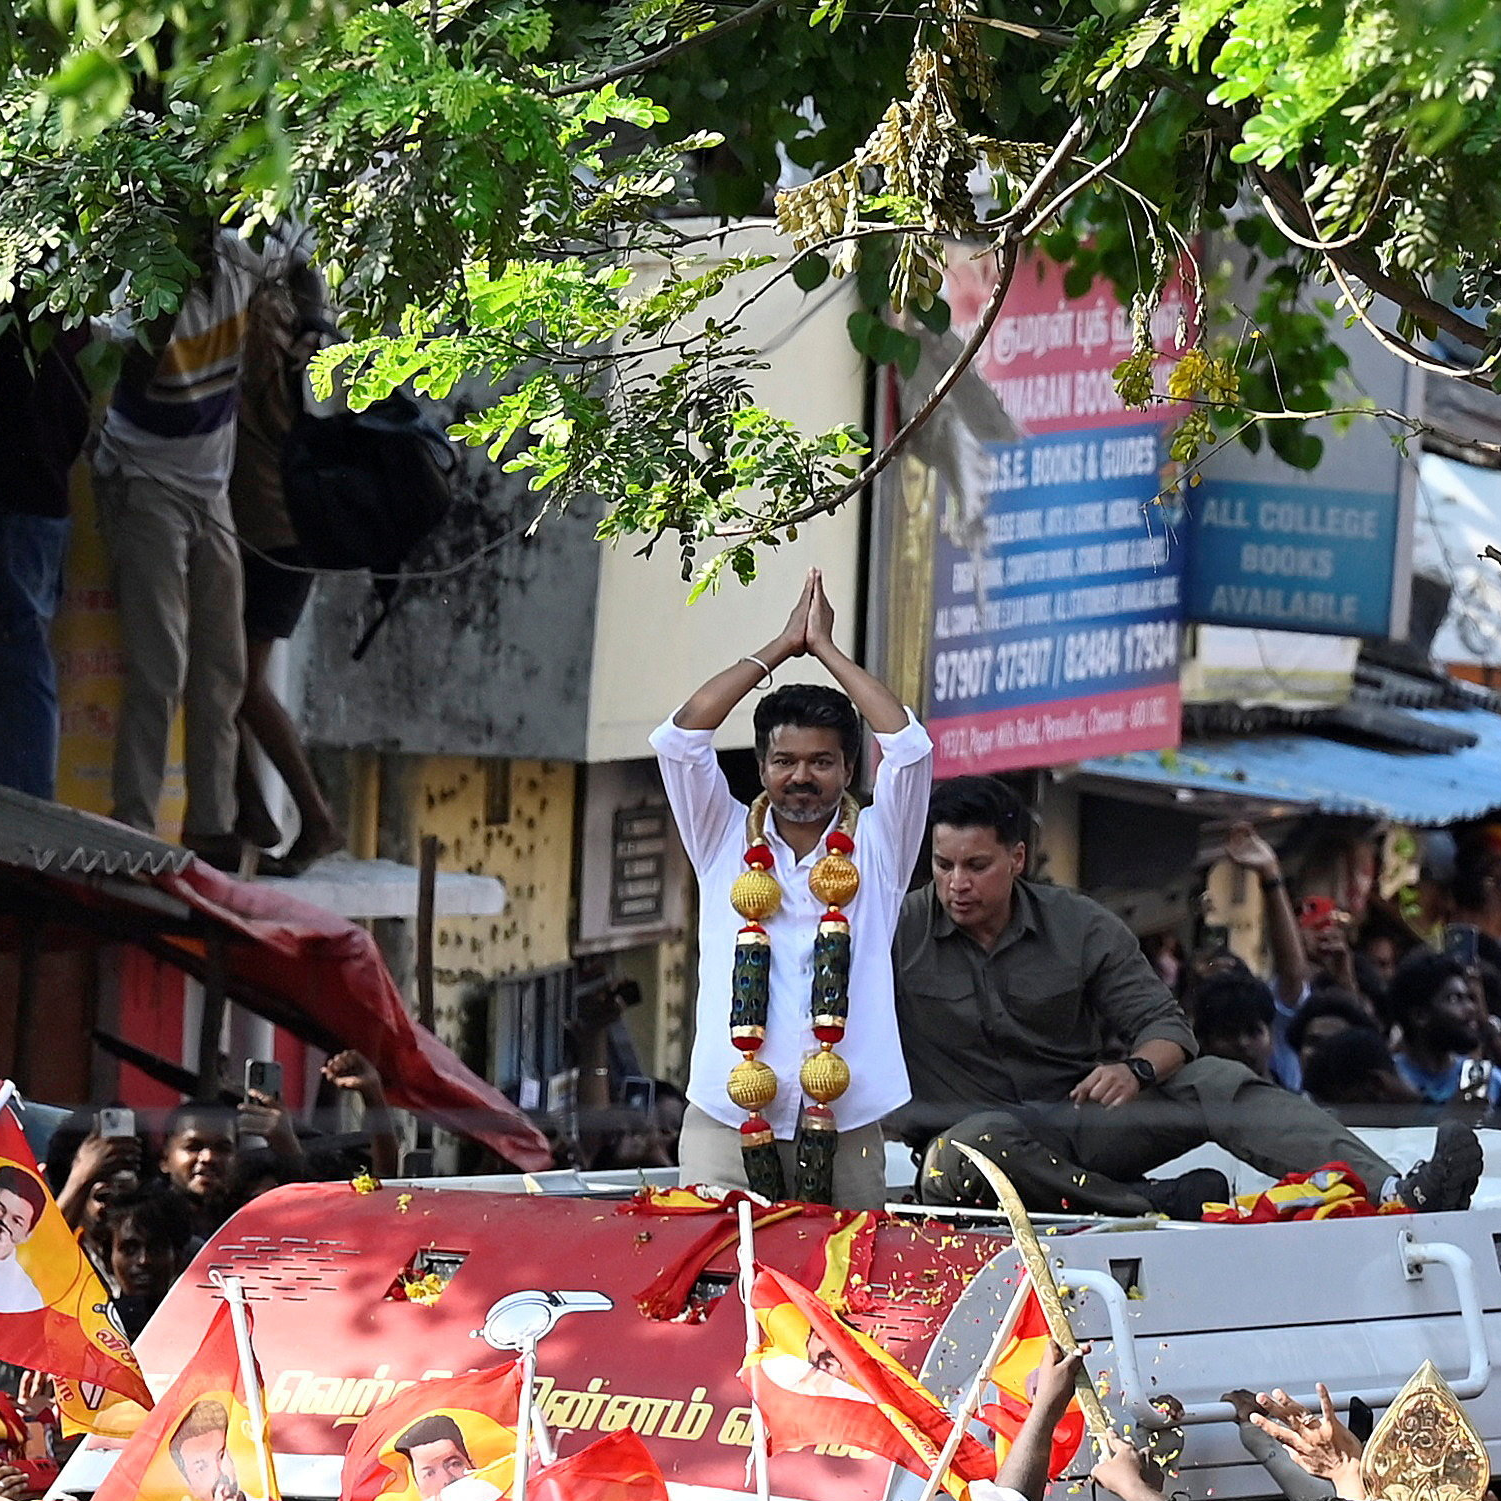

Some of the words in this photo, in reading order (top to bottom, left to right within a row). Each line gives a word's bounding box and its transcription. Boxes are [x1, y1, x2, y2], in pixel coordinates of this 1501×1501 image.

[1202, 497, 1249, 528] ALL
[1259, 501, 1380, 540] COLLEGE
[1240, 543, 1334, 580] BOOKS
[1211, 584, 1359, 625] AVAILABLE
[934, 646, 992, 702] 97907
[995, 636, 1052, 693] 37507
